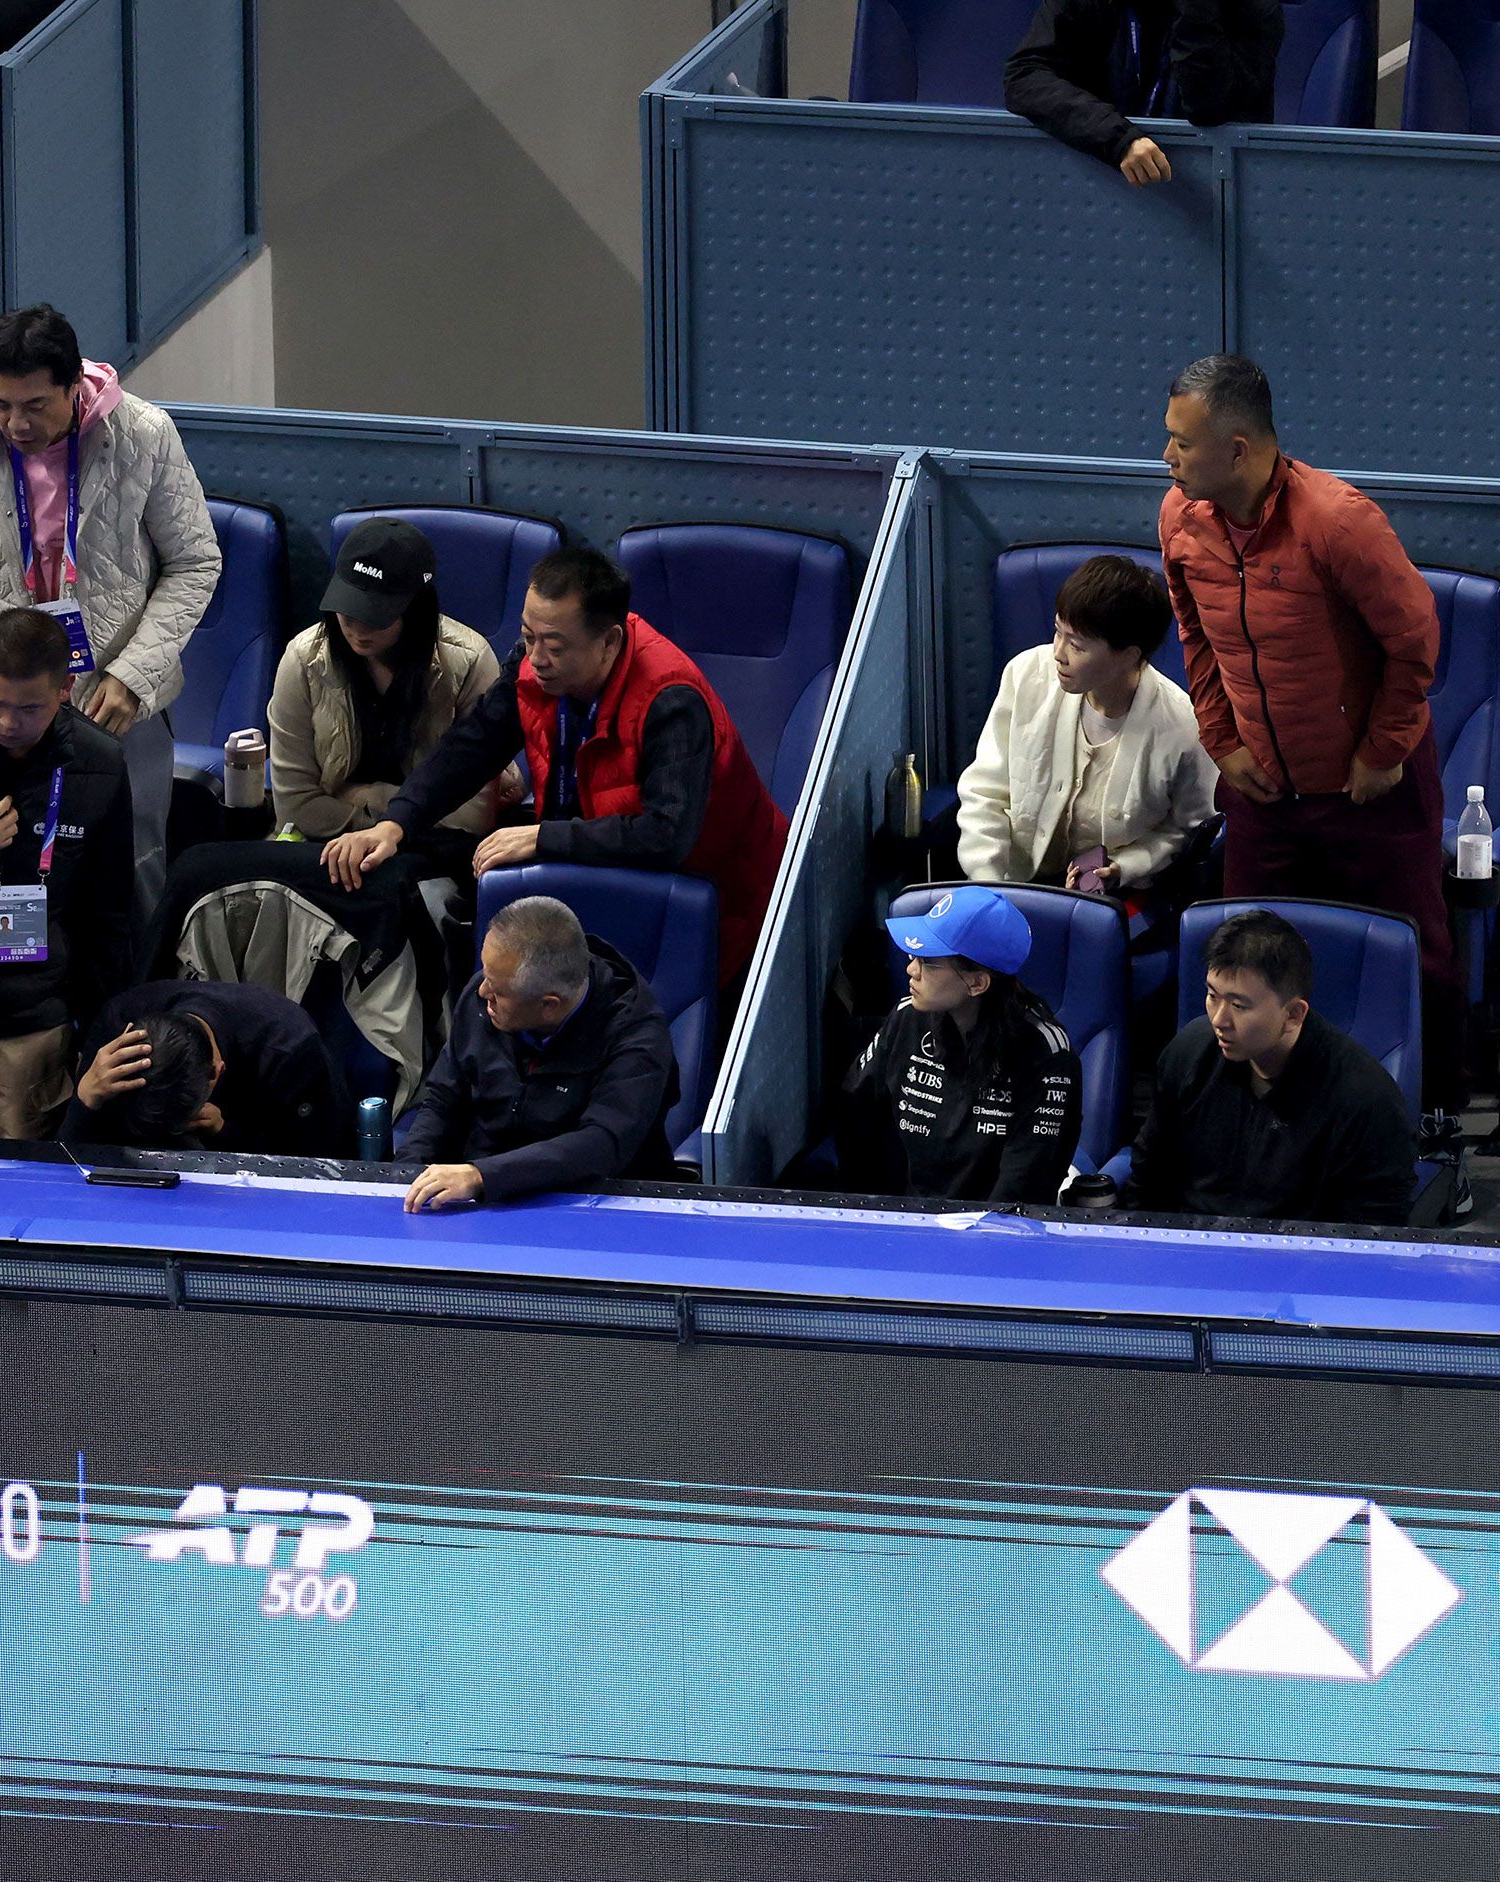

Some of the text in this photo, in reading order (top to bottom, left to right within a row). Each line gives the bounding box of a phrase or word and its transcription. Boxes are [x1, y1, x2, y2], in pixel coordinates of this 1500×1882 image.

[353, 561, 383, 580] MoMA
[918, 1071, 943, 1090] UBS
[907, 1103, 937, 1119] Snapdragon
[976, 1121, 1007, 1135] HPE
[120, 1484, 377, 1570] ATP
[260, 1569, 359, 1619] 500
